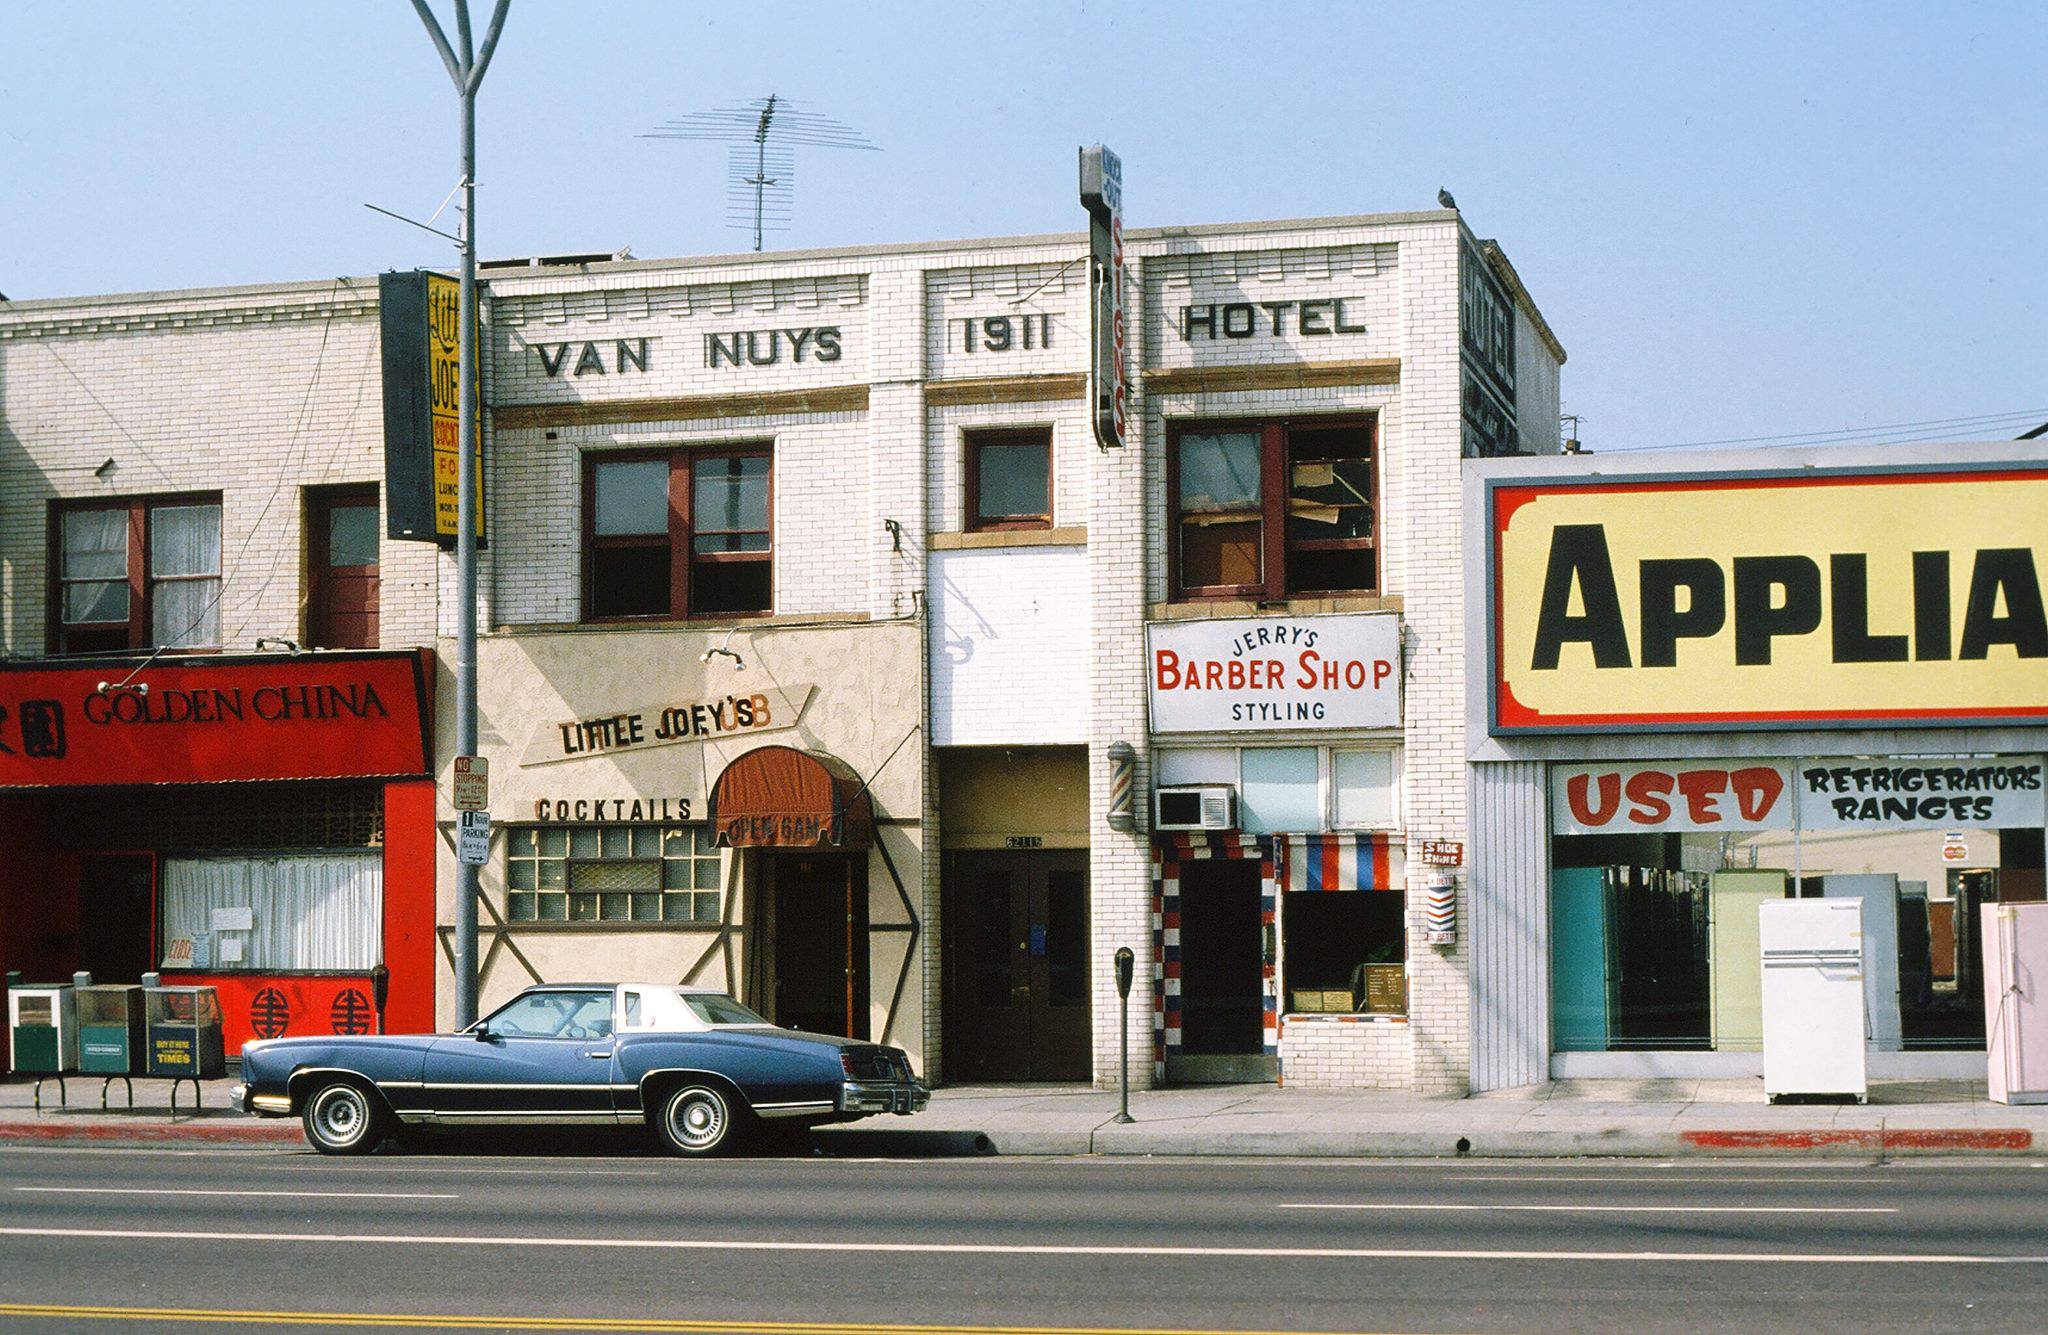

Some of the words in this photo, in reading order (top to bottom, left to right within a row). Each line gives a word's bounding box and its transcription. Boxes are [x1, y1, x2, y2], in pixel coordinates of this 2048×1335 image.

[430, 285, 460, 354] Litt
[962, 313, 1049, 353] 1911
[1112, 217, 1126, 437] SIGNS
[1181, 297, 1367, 342] HOTEL
[1461, 254, 1514, 391] HOTEL
[537, 336, 647, 377] VAN
[708, 325, 842, 368] NUYS
[1530, 523, 2048, 672] APPLIA
[1232, 625, 1319, 658] JERRY'S
[1156, 649, 1286, 690] BARBER
[1296, 649, 1392, 690] SHOP
[83, 687, 244, 726] GOLDEN
[251, 681, 392, 720] CHINA
[1232, 701, 1326, 721] STYLING
[561, 714, 645, 754] LITTLE
[654, 695, 754, 740] JOEY'S
[455, 773, 488, 784] STOPPING
[457, 759, 469, 771] NO
[1802, 763, 2042, 795] REFRIGERATORS
[535, 797, 691, 822] COCKTAILS
[1566, 766, 1784, 827] USED
[1831, 795, 1993, 822] RANGES
[463, 827, 488, 839] PARKING
[1424, 842, 1459, 854] SHOE
[156, 1053, 191, 1064] TIMES
